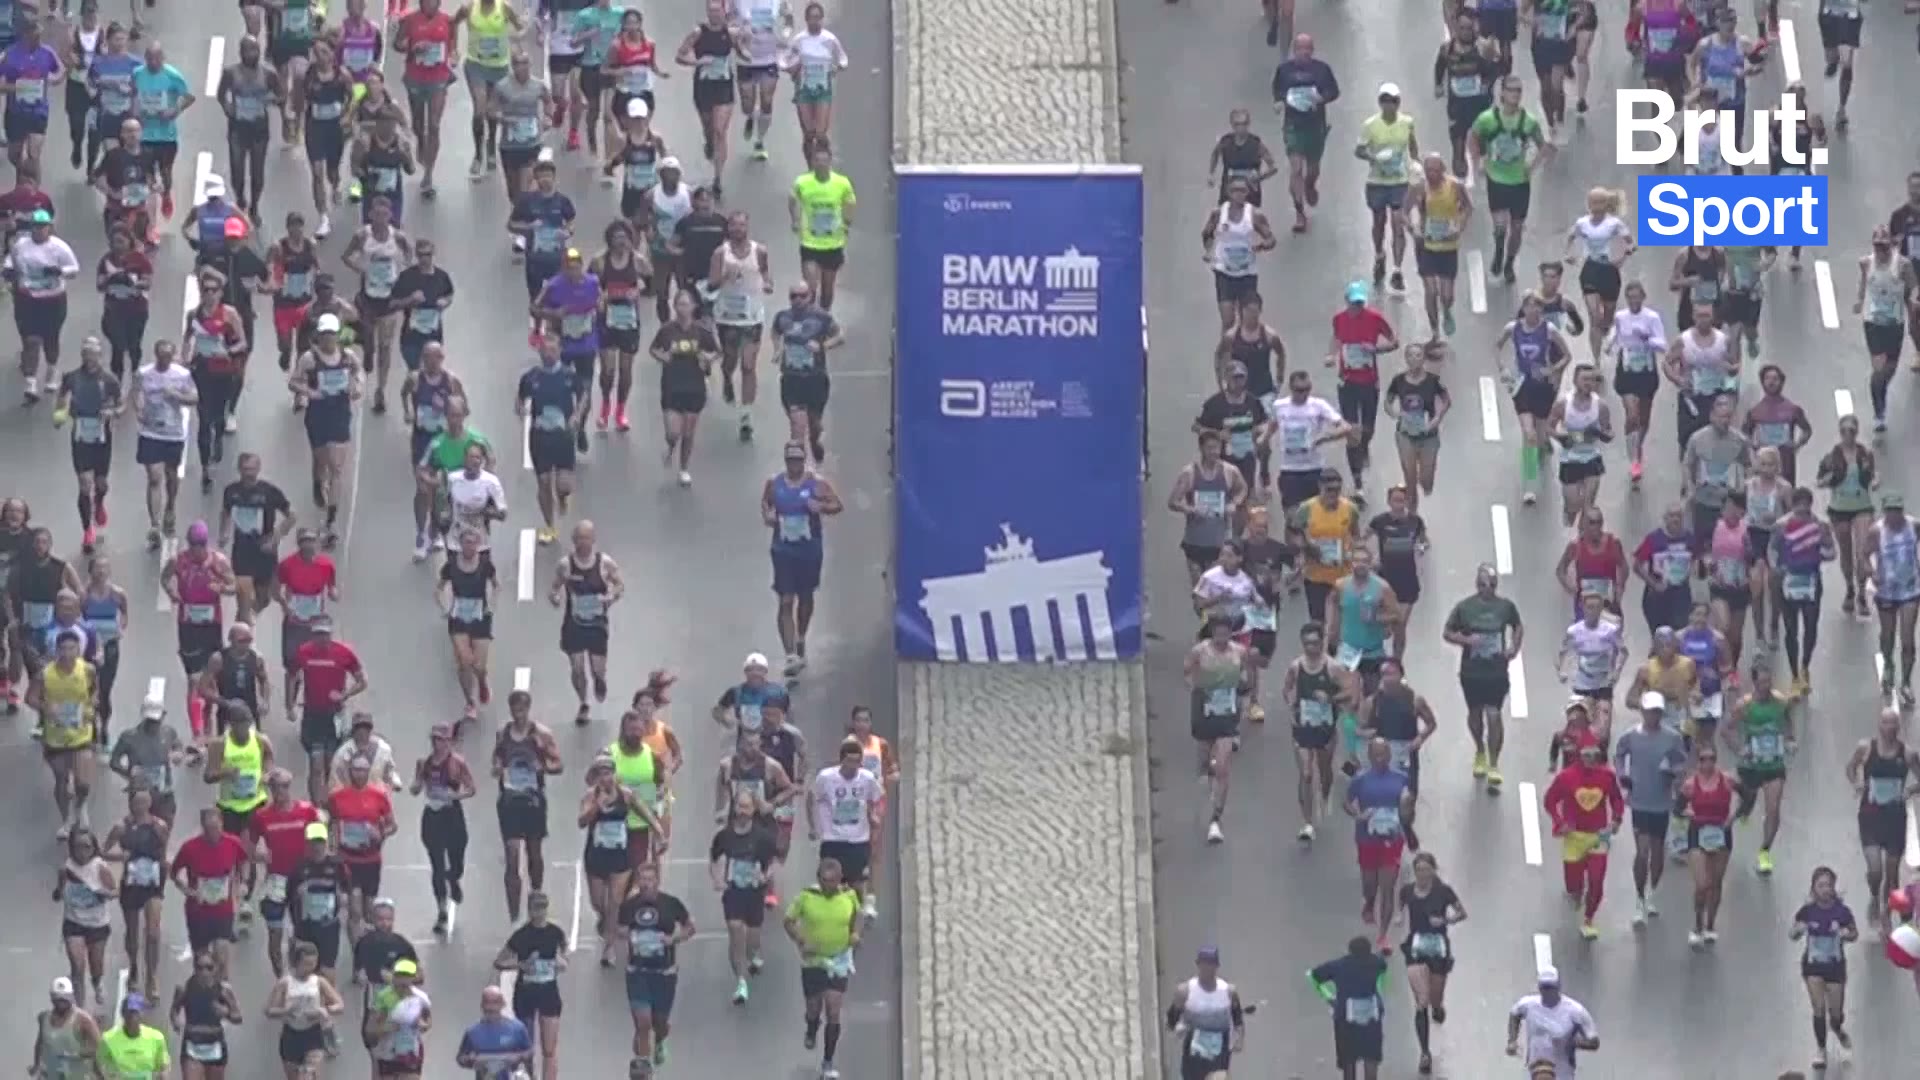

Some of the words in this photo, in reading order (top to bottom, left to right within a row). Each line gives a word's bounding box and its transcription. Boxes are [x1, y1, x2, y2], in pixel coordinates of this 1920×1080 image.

[943, 254, 1038, 286] BMW
[943, 288, 1038, 311] BERLIN
[943, 314, 1098, 337] MARATHON
